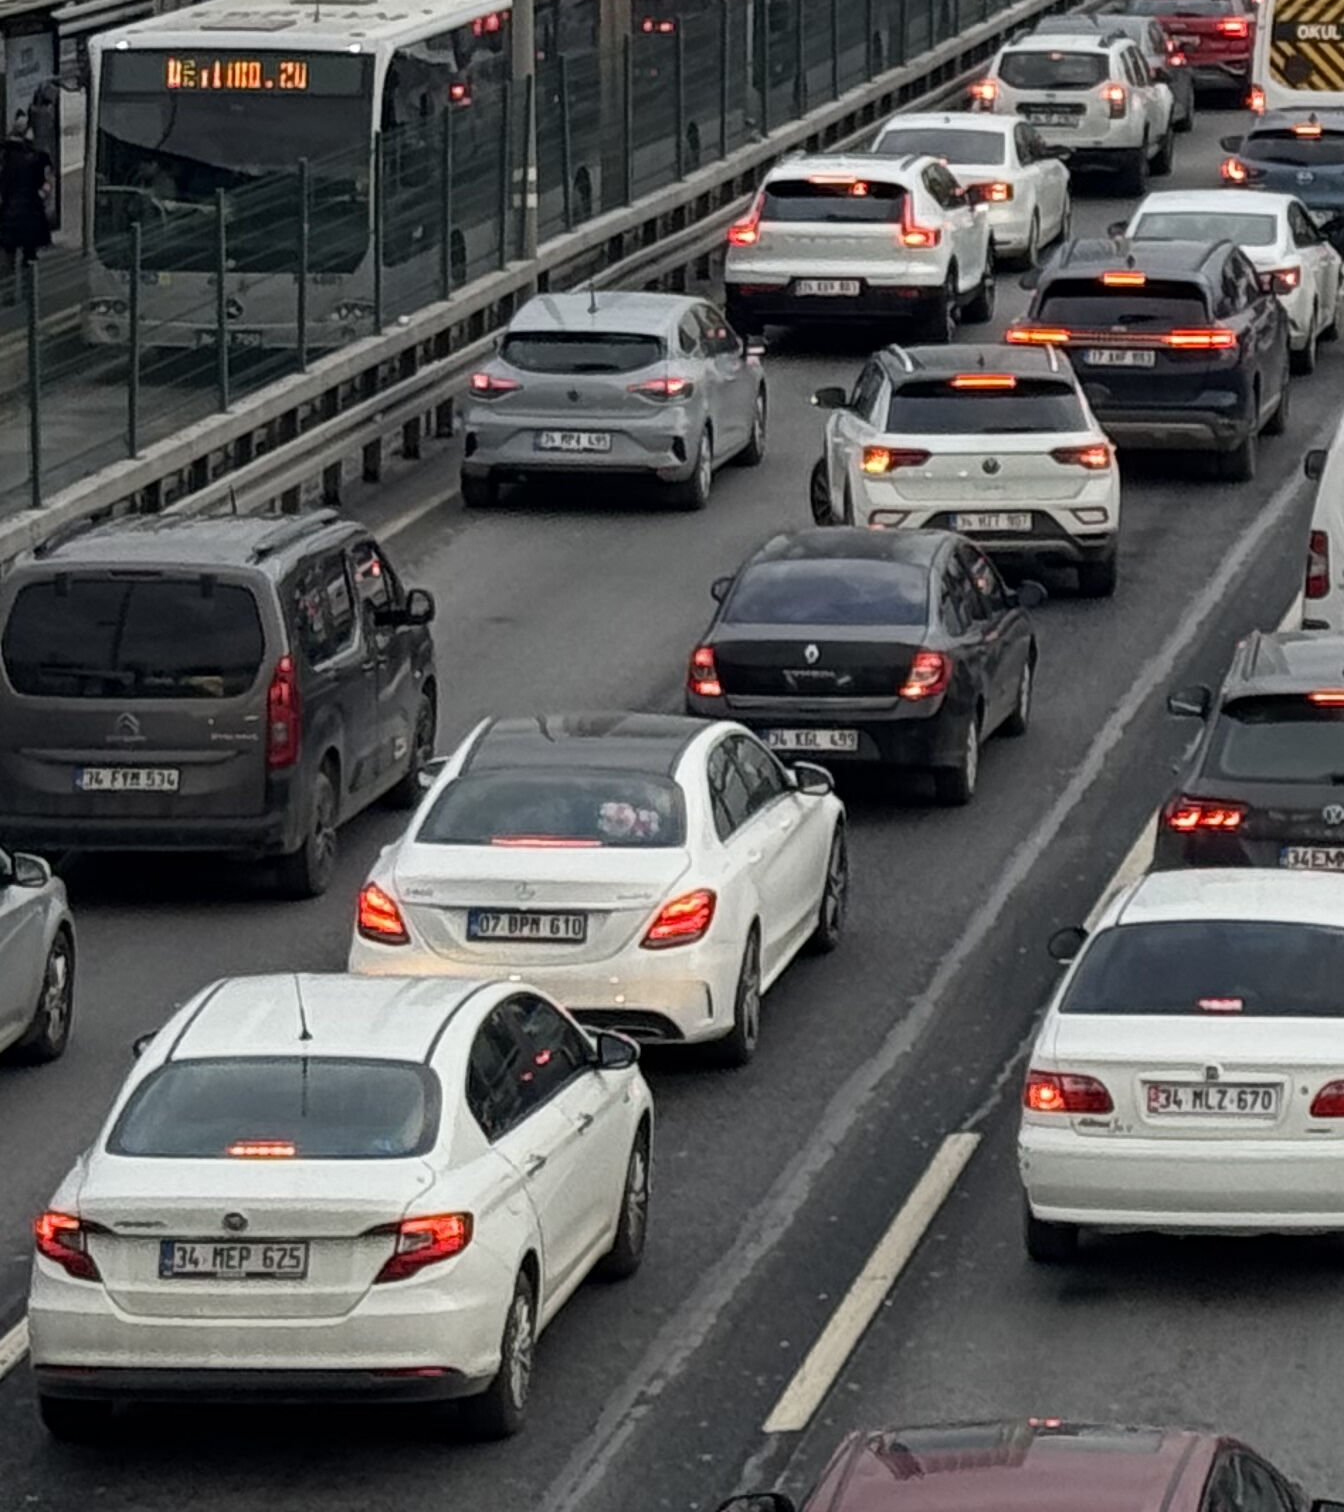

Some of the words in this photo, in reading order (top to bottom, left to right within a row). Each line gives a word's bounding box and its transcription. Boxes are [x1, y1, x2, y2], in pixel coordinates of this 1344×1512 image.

[1297, 24, 1341, 40] OKUL
[84, 771, 103, 786] 34
[480, 915, 500, 934] 07
[1160, 1089, 1182, 1109] 34
[1237, 1089, 1272, 1110] 670
[176, 1246, 199, 1269] 34
[262, 1246, 300, 1270] 625
